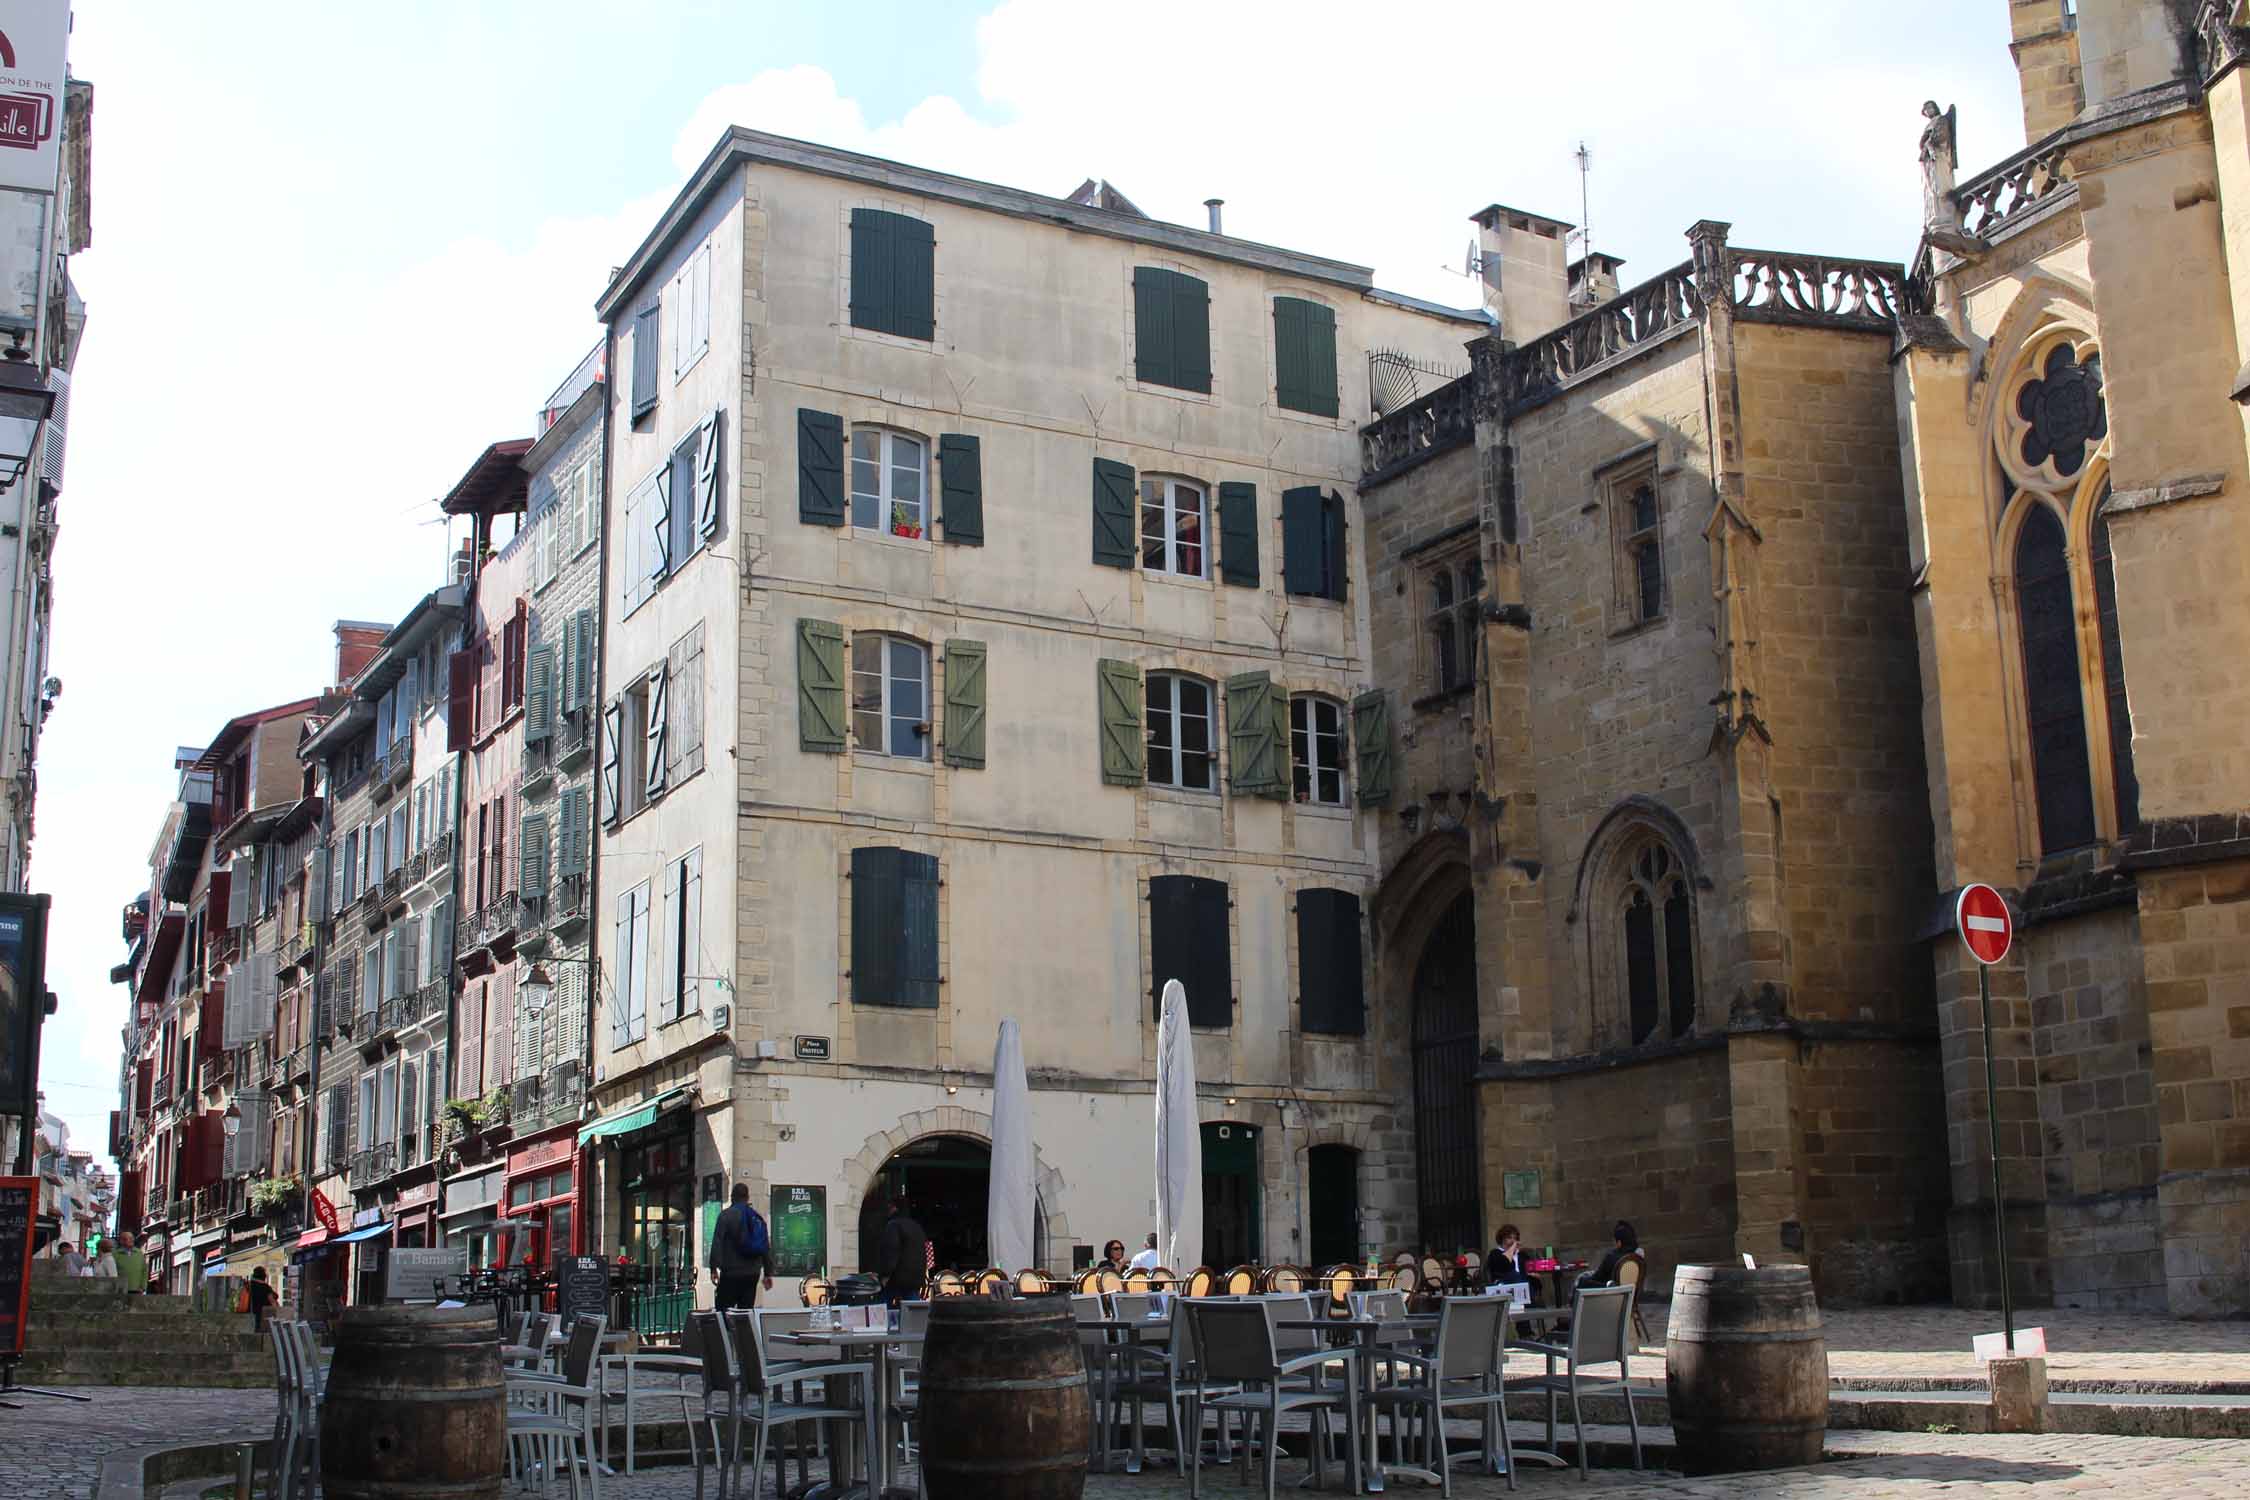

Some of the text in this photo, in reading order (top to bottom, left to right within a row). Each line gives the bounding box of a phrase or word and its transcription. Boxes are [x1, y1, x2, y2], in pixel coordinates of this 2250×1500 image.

[19, 80, 31, 88] DE
[35, 81, 52, 90] THE
[0, 108, 28, 136] ille
[315, 1193, 337, 1230] TABAC
